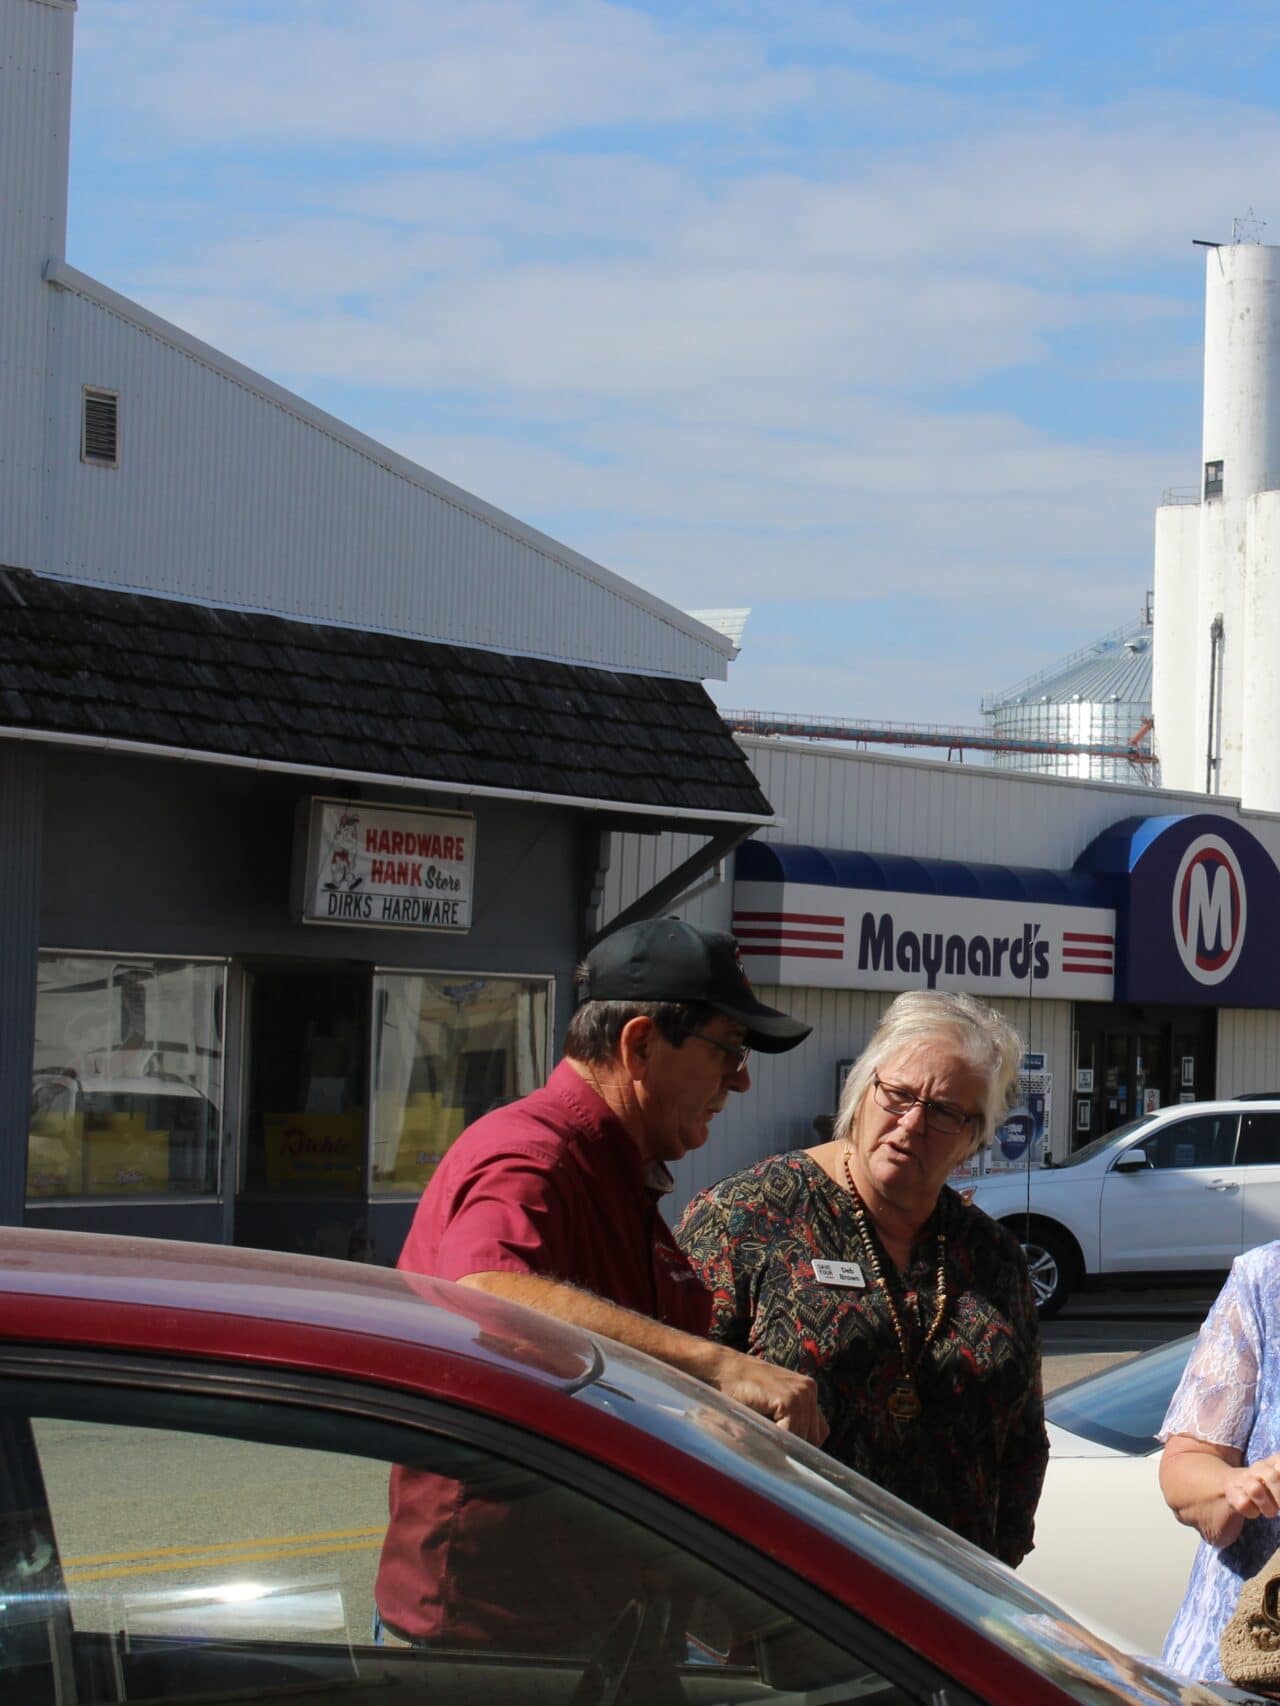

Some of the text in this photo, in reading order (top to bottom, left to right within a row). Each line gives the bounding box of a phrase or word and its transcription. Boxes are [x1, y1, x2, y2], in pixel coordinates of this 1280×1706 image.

[366, 829, 465, 861] HARDWARE
[371, 859, 461, 892] HANK Store
[328, 893, 459, 924] DIRKS HARDWARE
[1184, 862, 1234, 966] M
[858, 912, 1049, 989] Maynard's
